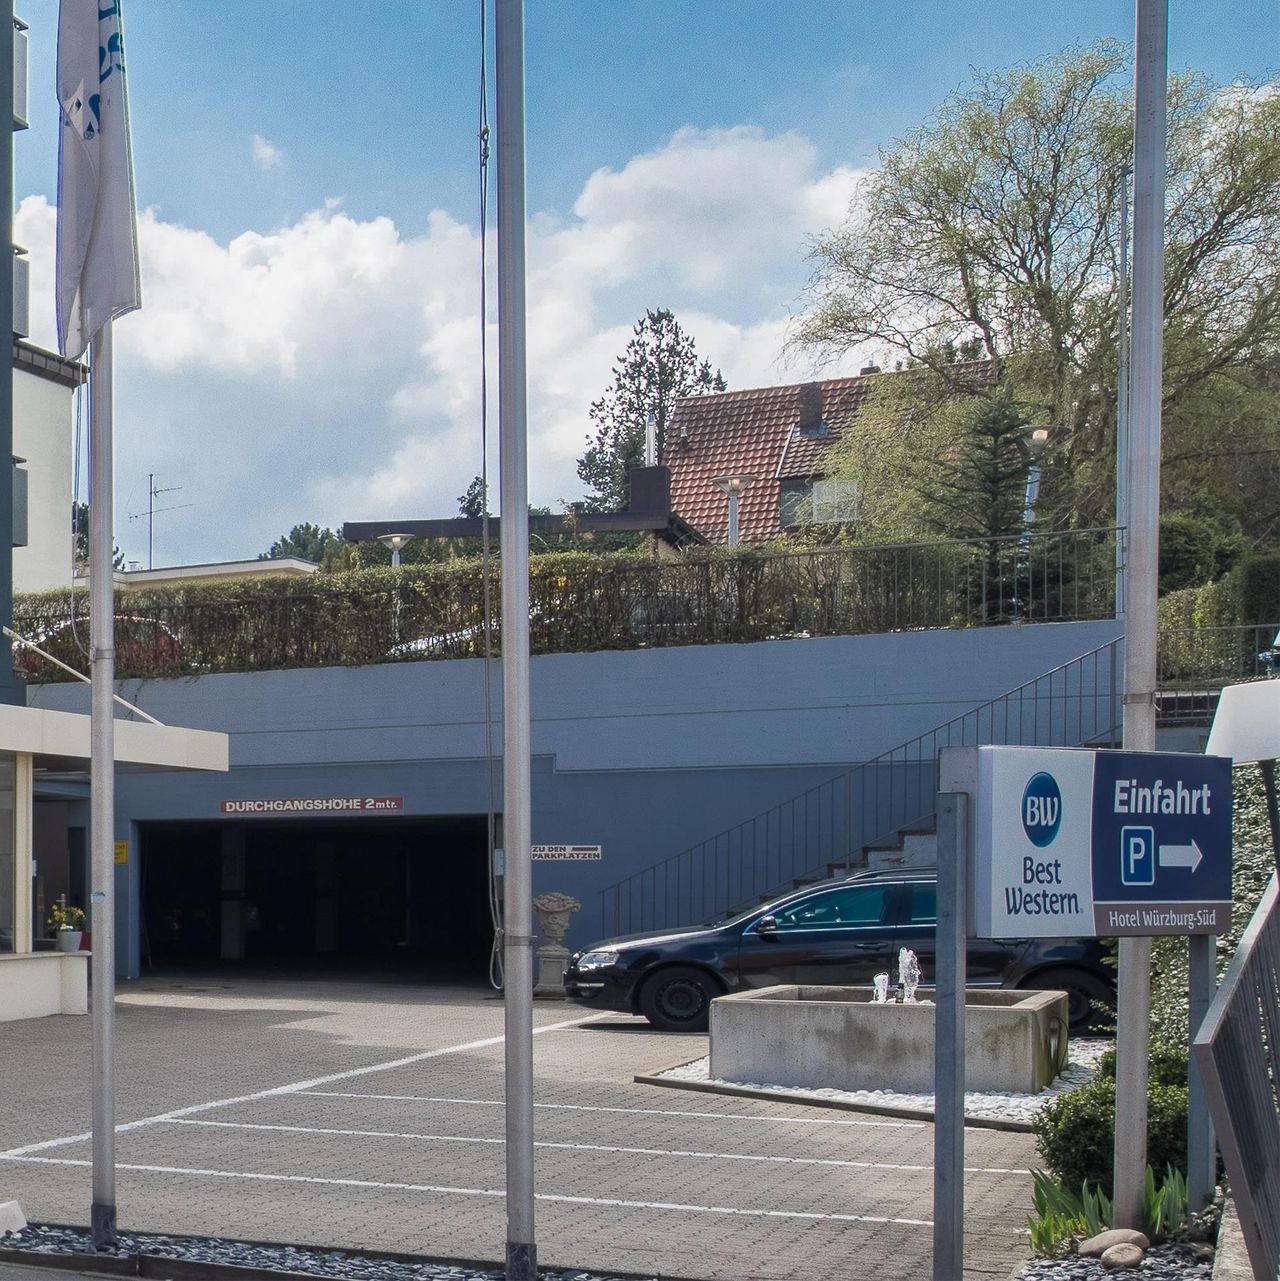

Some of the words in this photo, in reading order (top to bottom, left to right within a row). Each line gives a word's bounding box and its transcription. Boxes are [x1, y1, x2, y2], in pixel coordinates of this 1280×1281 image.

[225, 797, 362, 812] DURCHGANGSHÖHE
[1026, 795, 1059, 827] BW
[1113, 778, 1212, 816] Einfahrt
[1129, 837, 1146, 874] P
[1022, 856, 1062, 885] Best
[1004, 887, 1080, 916] Western
[1109, 910, 1141, 927] Hotel
[1142, 909, 1217, 930] Würzburg-Süd
